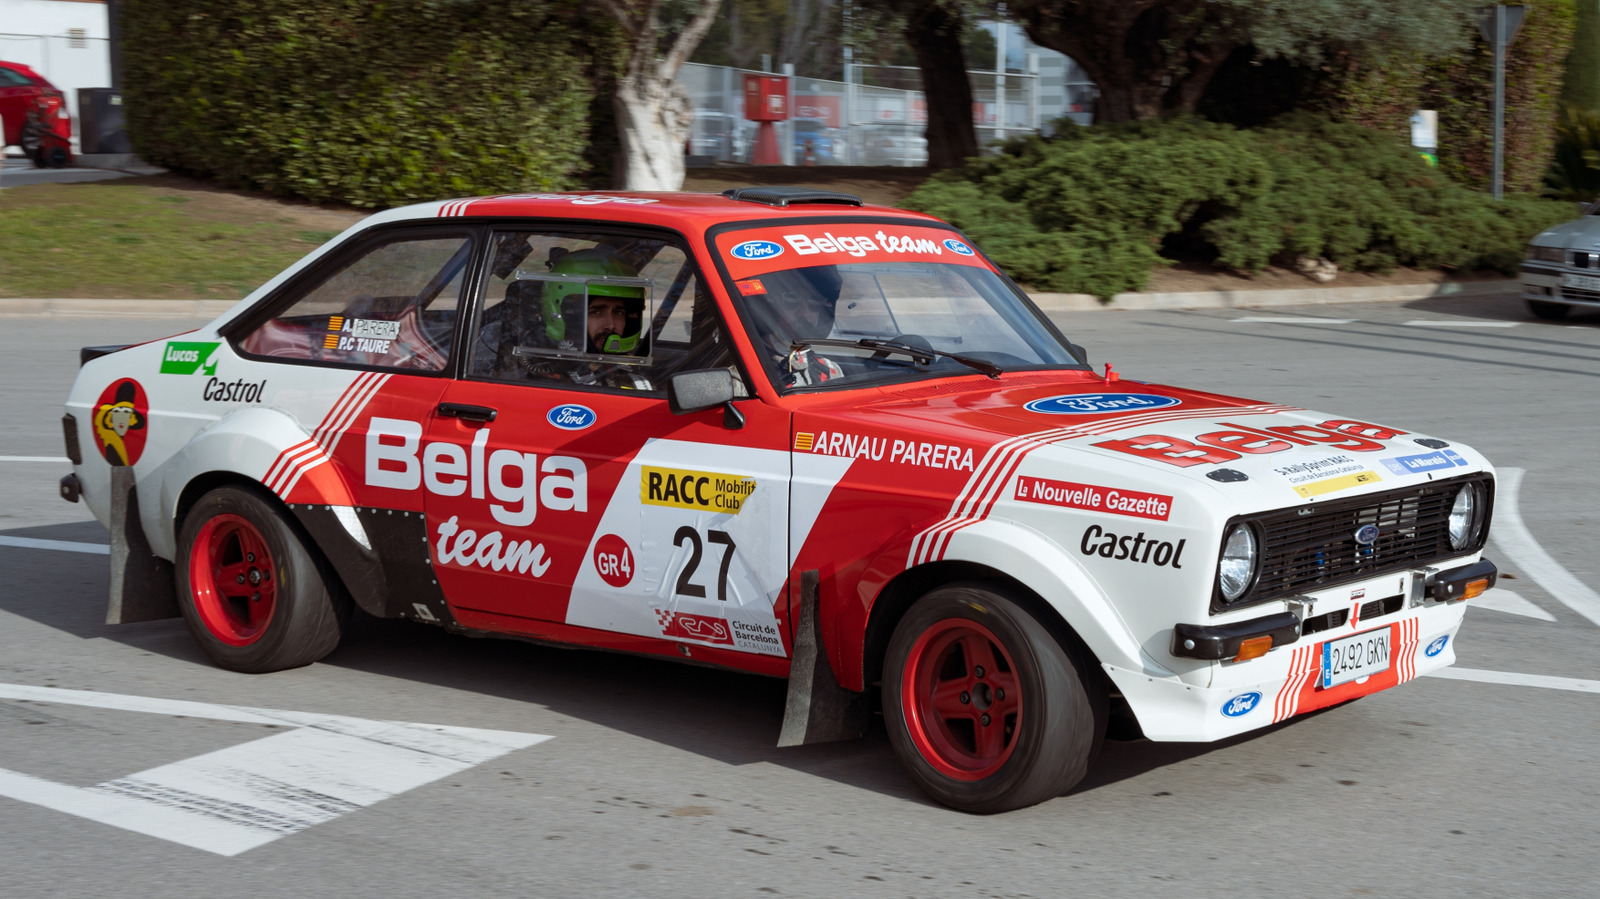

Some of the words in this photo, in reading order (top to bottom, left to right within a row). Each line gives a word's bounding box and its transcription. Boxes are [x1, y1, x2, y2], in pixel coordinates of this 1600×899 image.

[743, 242, 774, 257] Ford
[783, 233, 879, 257] Belga
[875, 230, 942, 255] team
[356, 320, 396, 336] PARERA
[166, 346, 199, 362] Lucas
[356, 338, 391, 354] TAURE
[203, 377, 267, 403] Castrol
[1055, 396, 1155, 411] Ford
[556, 407, 585, 426] Ford
[813, 431, 888, 462] ARNAU
[889, 439, 975, 473] PARERA
[1088, 419, 1411, 468] Belga
[364, 416, 589, 527] Belga
[649, 472, 710, 507] RACC
[1017, 480, 1028, 498] La
[1032, 481, 1102, 508] Nouvelle
[1105, 491, 1169, 517] Gazette
[715, 494, 740, 510] Club
[436, 515, 552, 578] team
[1080, 524, 1187, 570] Castrol
[673, 525, 737, 602] 27
[732, 621, 763, 633] Circuit
[764, 625, 776, 635] de
[735, 630, 779, 645] Barcelona
[738, 640, 782, 653] CATALUNYA
[1333, 642, 1363, 675] 2492
[1366, 635, 1388, 665] GKN
[1325, 669, 1330, 679] E
[1228, 694, 1256, 715] Ford
